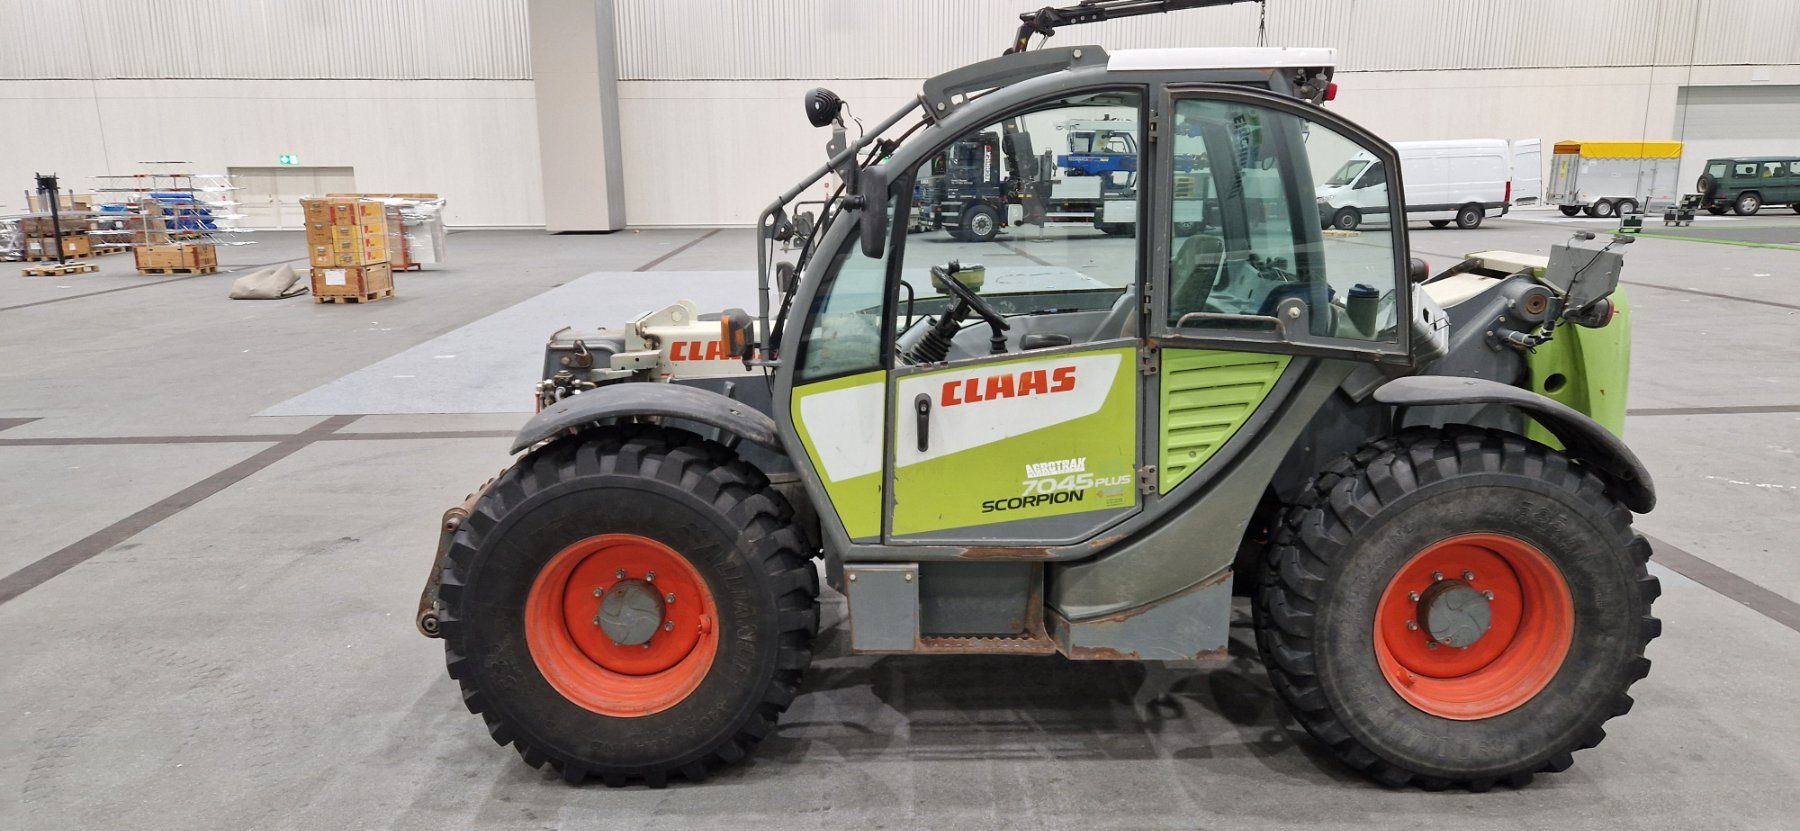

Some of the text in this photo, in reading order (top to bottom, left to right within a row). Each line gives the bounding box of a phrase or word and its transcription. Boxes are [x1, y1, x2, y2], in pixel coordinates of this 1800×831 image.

[669, 340, 770, 361] CLA
[941, 366, 1076, 407] CLAAS
[1025, 457, 1087, 478] AGROTRAK
[1021, 473, 1094, 497] 7045
[1095, 475, 1131, 488] PLUS
[982, 489, 1084, 513] SCORPION
